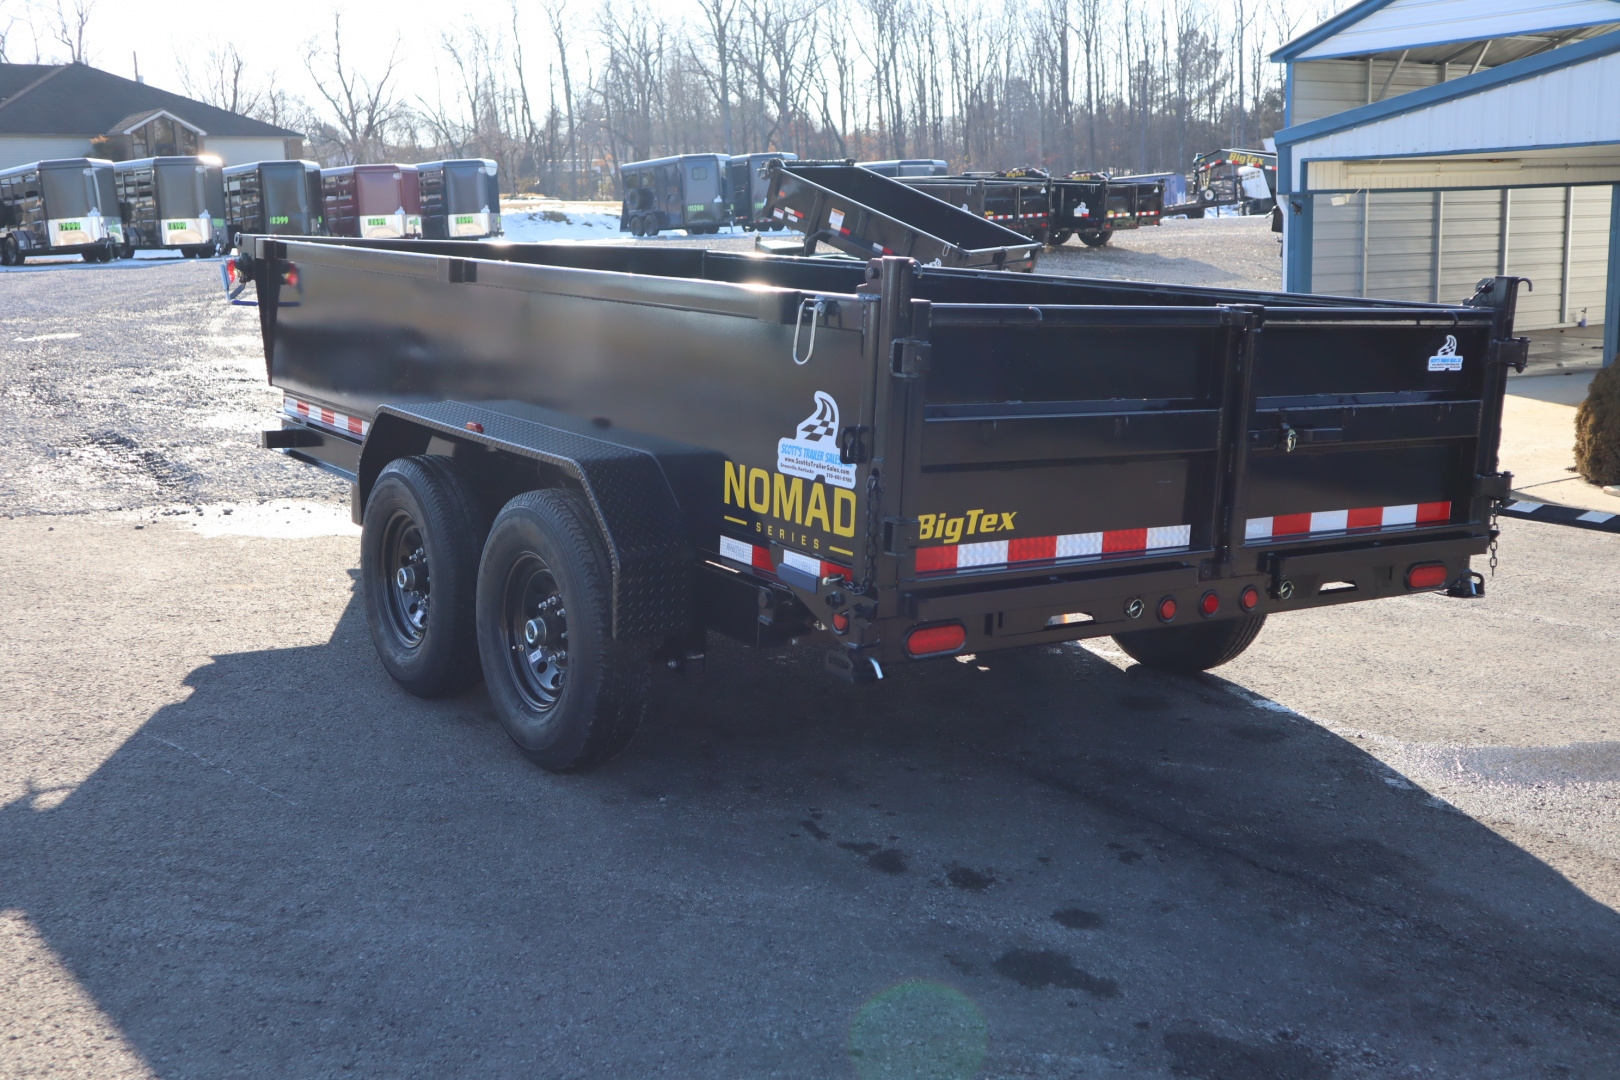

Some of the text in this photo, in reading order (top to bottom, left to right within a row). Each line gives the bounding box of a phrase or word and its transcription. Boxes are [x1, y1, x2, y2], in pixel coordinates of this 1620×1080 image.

[1229, 153, 1264, 165] BigTex
[781, 444, 803, 457] SCOTT'S
[804, 448, 825, 461] TRAILER
[724, 460, 857, 538] NOMAD
[756, 522, 819, 549] SERIES
[918, 509, 1018, 544] BigTex
